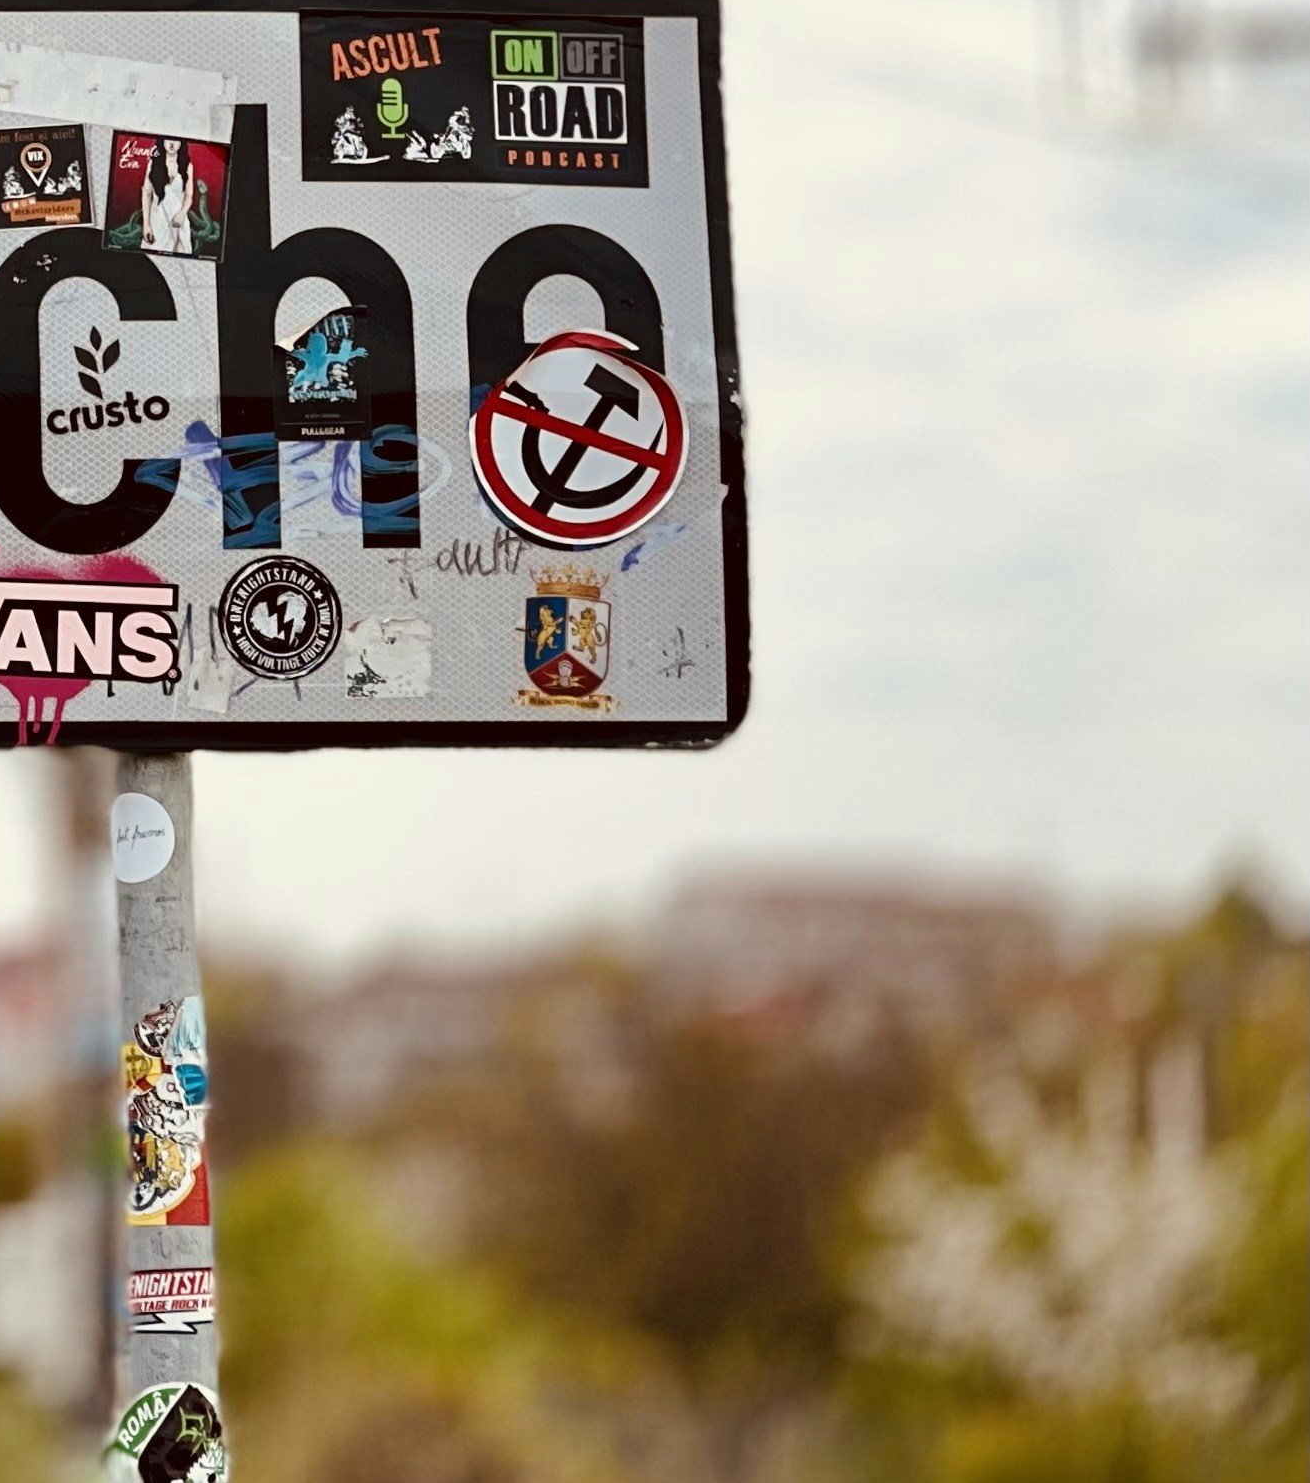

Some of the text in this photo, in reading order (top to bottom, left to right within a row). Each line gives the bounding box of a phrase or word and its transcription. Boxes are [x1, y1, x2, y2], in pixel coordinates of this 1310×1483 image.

[331, 27, 442, 82] ASCULT
[504, 38, 618, 75] ON OFF
[496, 83, 625, 141] ROAD
[507, 148, 621, 170] PODCAST
[46, 391, 171, 435] crusto
[229, 567, 316, 623] ONENIGHTSTAND
